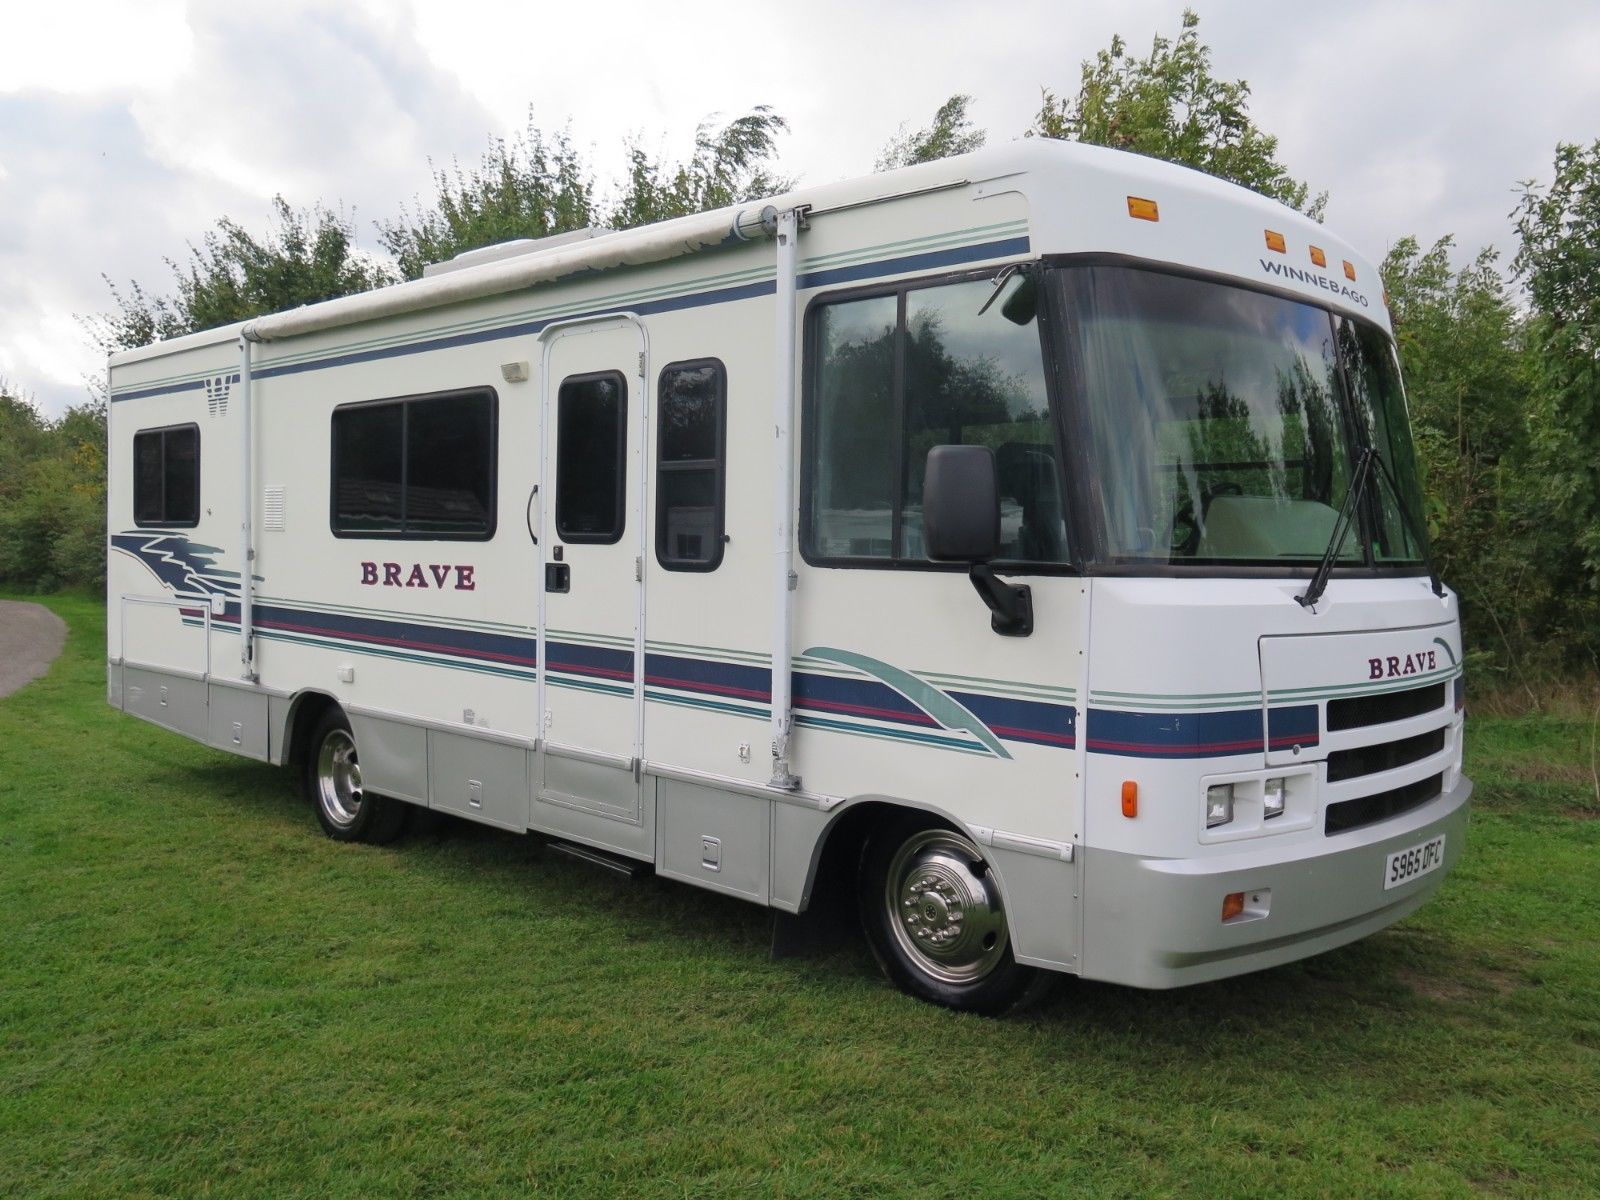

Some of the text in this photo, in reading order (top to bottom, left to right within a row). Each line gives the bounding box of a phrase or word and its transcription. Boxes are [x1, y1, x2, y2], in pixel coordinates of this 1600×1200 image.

[1259, 258, 1369, 308] WINNEBAGO
[360, 562, 476, 591] BRAVE
[1368, 650, 1437, 680] BRAVE
[1390, 840, 1442, 882] S965 DFC
